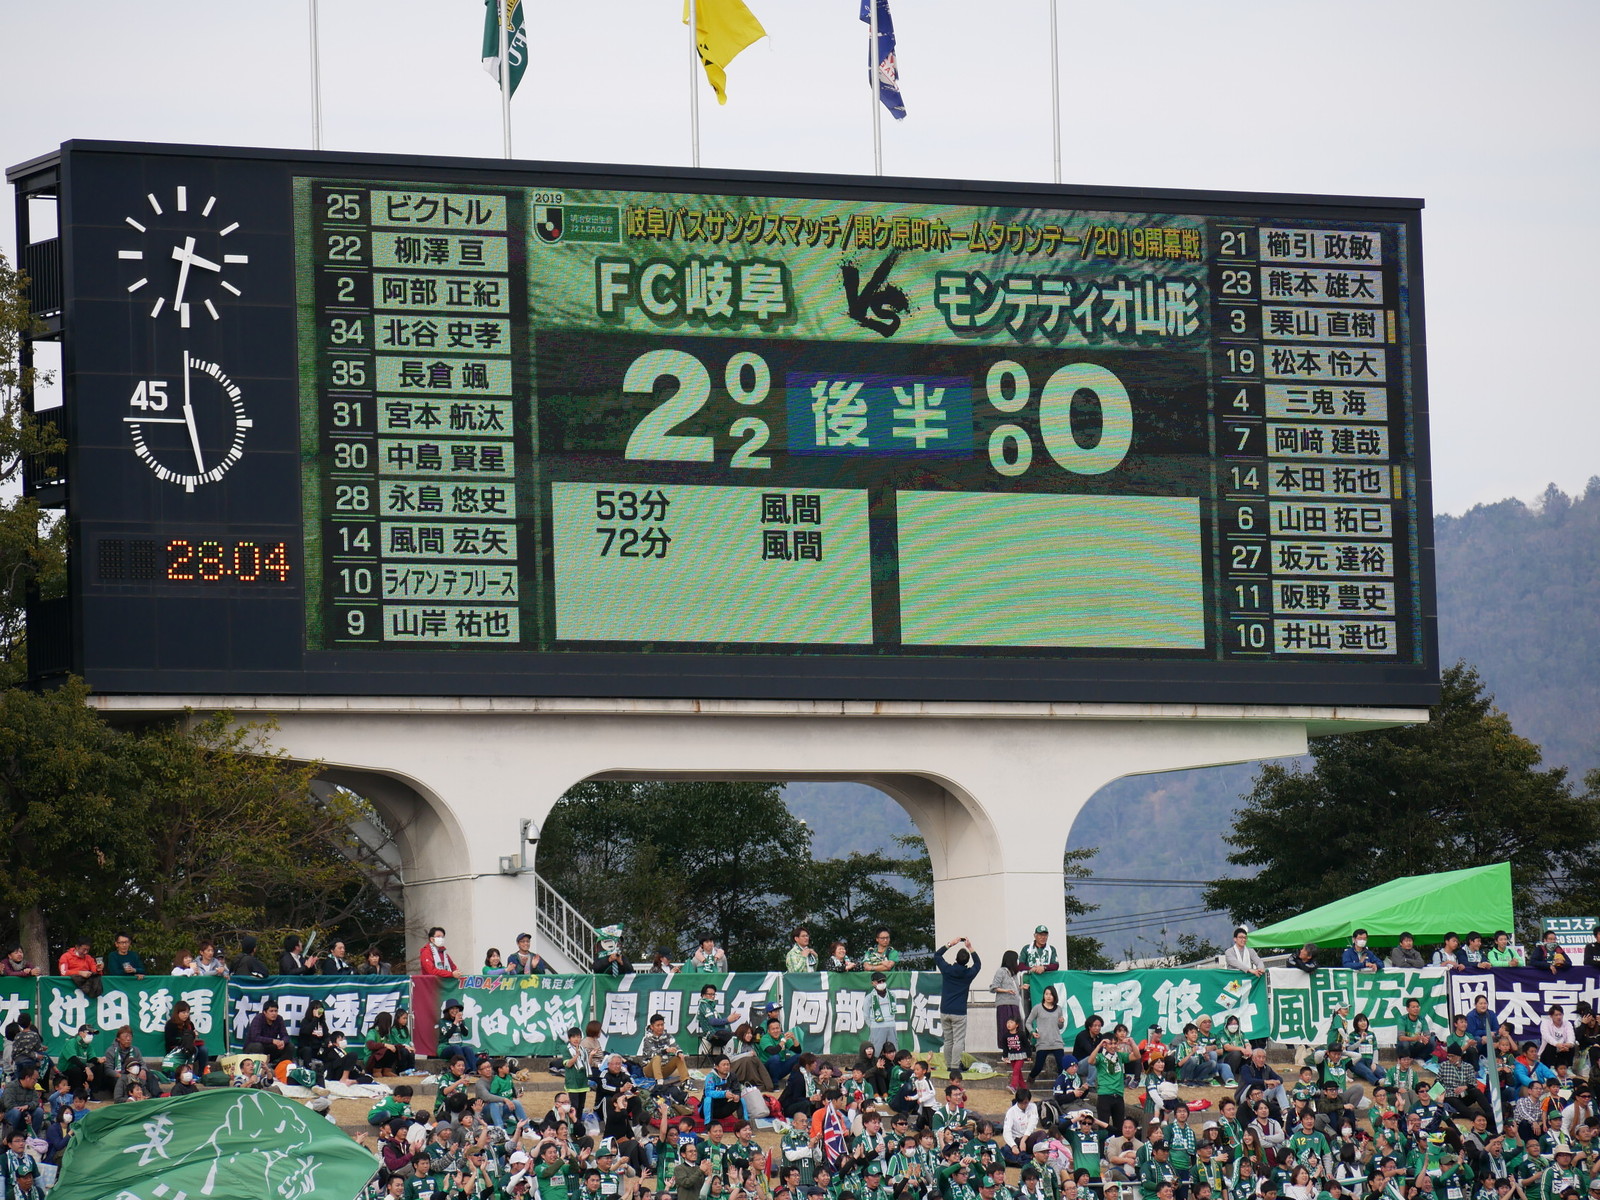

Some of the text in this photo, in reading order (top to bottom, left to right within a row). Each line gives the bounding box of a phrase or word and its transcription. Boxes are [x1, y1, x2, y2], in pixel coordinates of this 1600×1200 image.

[327, 194, 492, 225] 25 ビクトル
[535, 193, 562, 203] 2019
[328, 236, 361, 261] 22
[394, 237, 449, 264] 柳澤
[1220, 231, 1373, 260] 21 櫛引 政敏
[338, 277, 501, 307] 2 阿部 正紀
[599, 260, 786, 320] FC岐阜
[1222, 270, 1375, 299] 23 熊本 雄太
[939, 277, 1200, 336] モンテディオ山形
[331, 319, 502, 349] 34 北谷 史孝
[1231, 309, 1376, 338] 3 栗山 直樹
[332, 360, 489, 389] 35 長倉 颯
[1227, 349, 1378, 377] 19 松本 怜大
[725, 352, 770, 405] 0
[986, 360, 1030, 413] 0
[130, 381, 168, 411] 45
[623, 348, 714, 462] 2
[1233, 389, 1367, 415] 4 三鬼 海
[334, 402, 504, 430] 31 宮本 航汰
[810, 380, 949, 449] 後半
[1039, 362, 1133, 475] 0
[729, 416, 771, 469] 2
[988, 424, 1032, 477] 0
[1234, 427, 1250, 450] 7
[1331, 428, 1380, 455] 建哉
[335, 443, 506, 472] 30 中島 賢星
[1231, 467, 1381, 493] 14 本田 拓也
[336, 485, 507, 513] 28 永島 悠史
[596, 490, 821, 525] 53分 風間
[1238, 507, 1253, 529] 6
[1278, 506, 1326, 532] 山田
[339, 526, 508, 554] 14 風間 宏矢
[596, 527, 822, 561] 72分 風間
[1232, 545, 1385, 573] 27 坂元 達裕
[340, 569, 372, 593] 10
[1235, 584, 1387, 610] 11 阪野 豊史
[347, 609, 510, 637] 9 山岸 祐也
[1238, 624, 1265, 648] 10
[1283, 623, 1331, 649] 井出
[1547, 919, 1596, 930] エコステ
[1296, 1136, 1306, 1146] 12
[802, 1158, 809, 1168] 12
